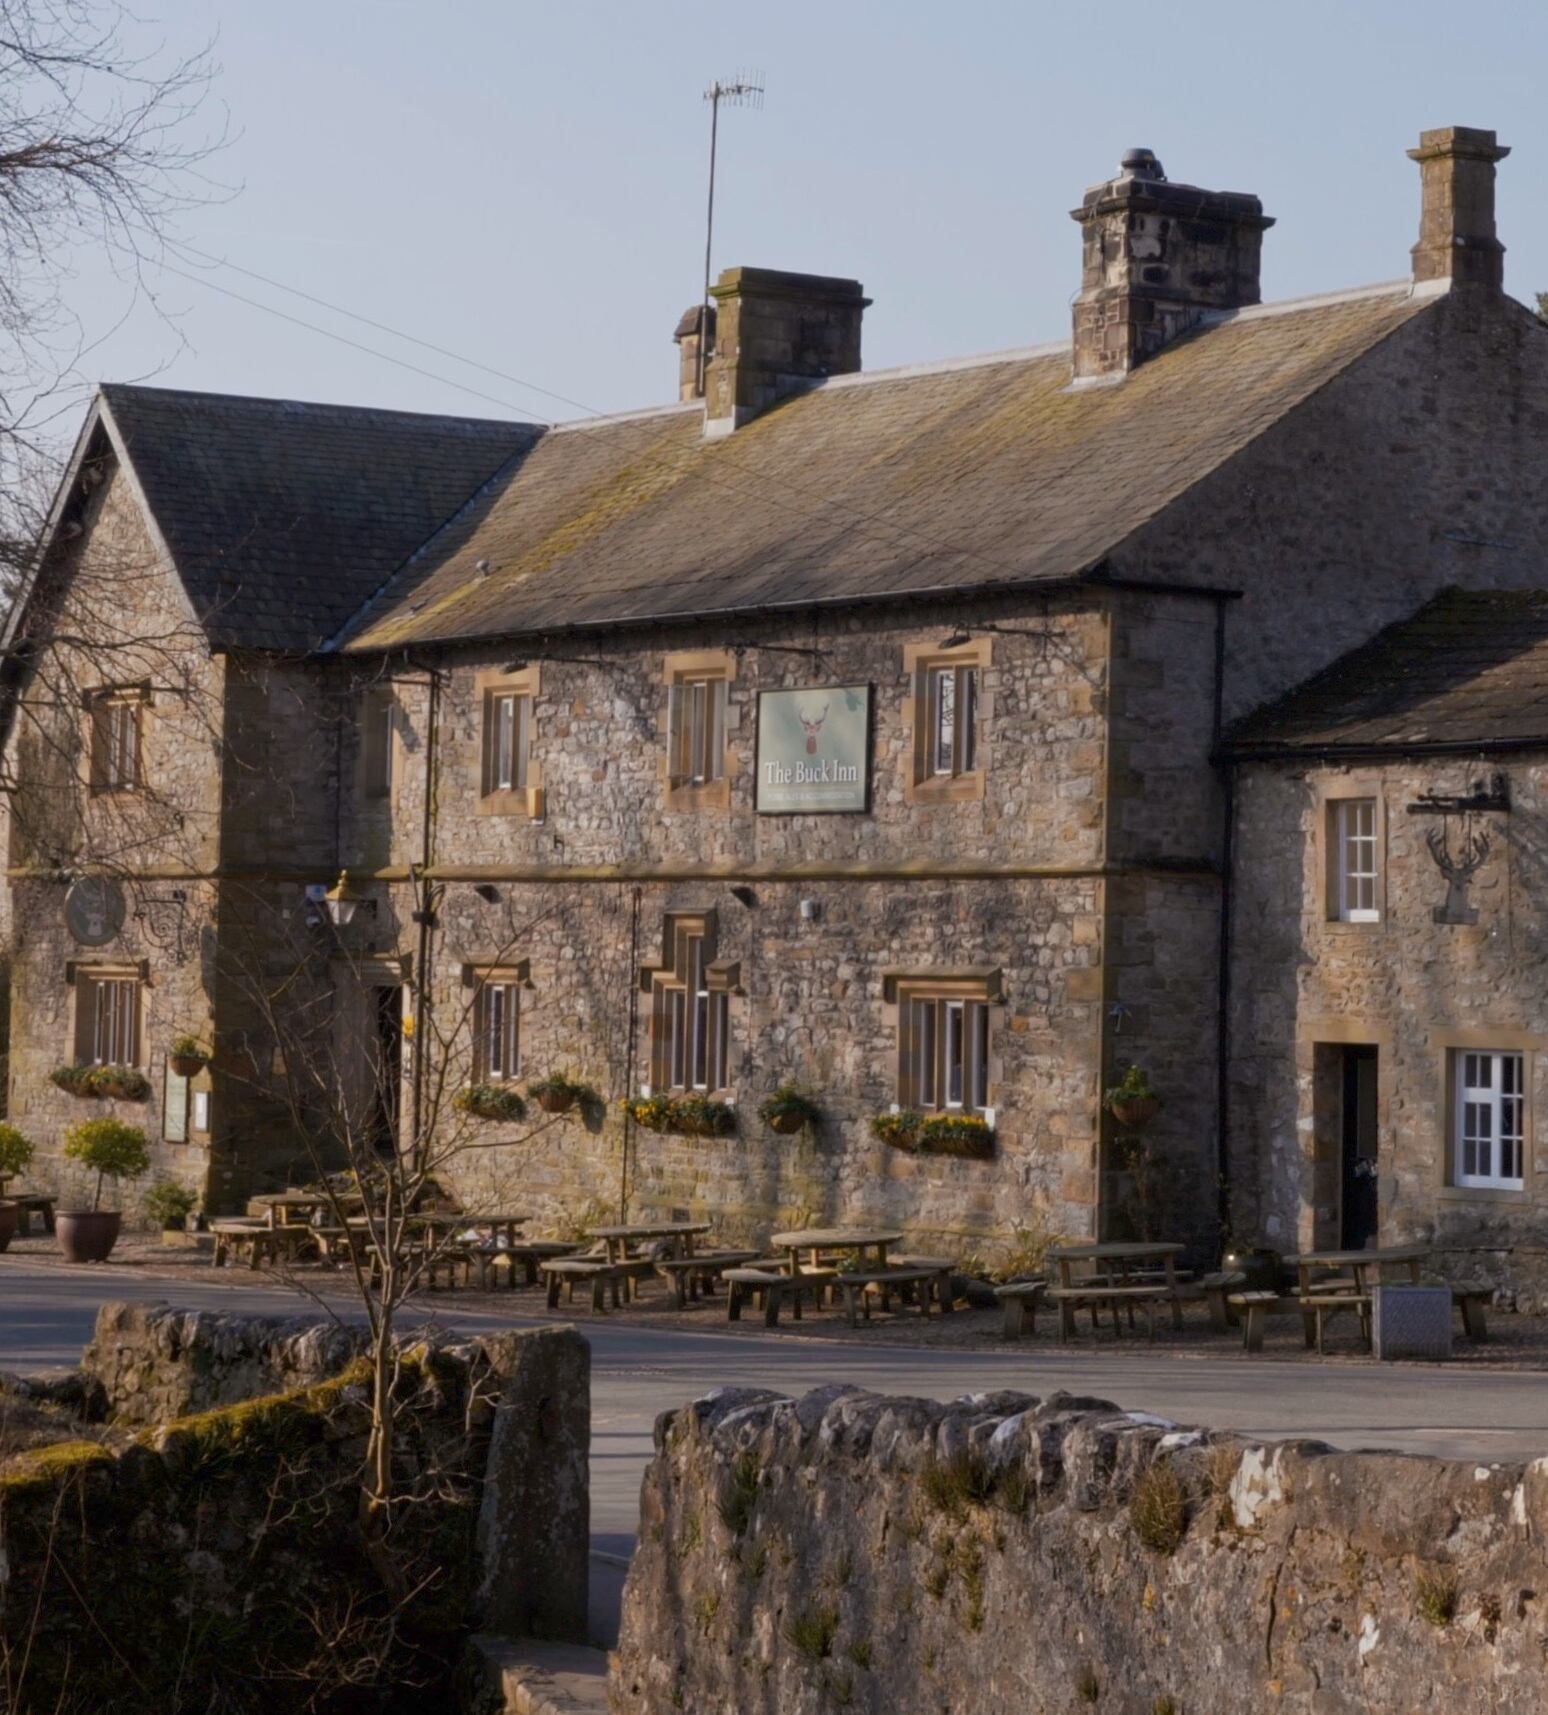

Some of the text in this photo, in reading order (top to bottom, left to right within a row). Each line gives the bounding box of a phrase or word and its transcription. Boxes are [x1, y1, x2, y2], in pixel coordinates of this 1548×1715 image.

[765, 760, 857, 784] The Buck Inn
